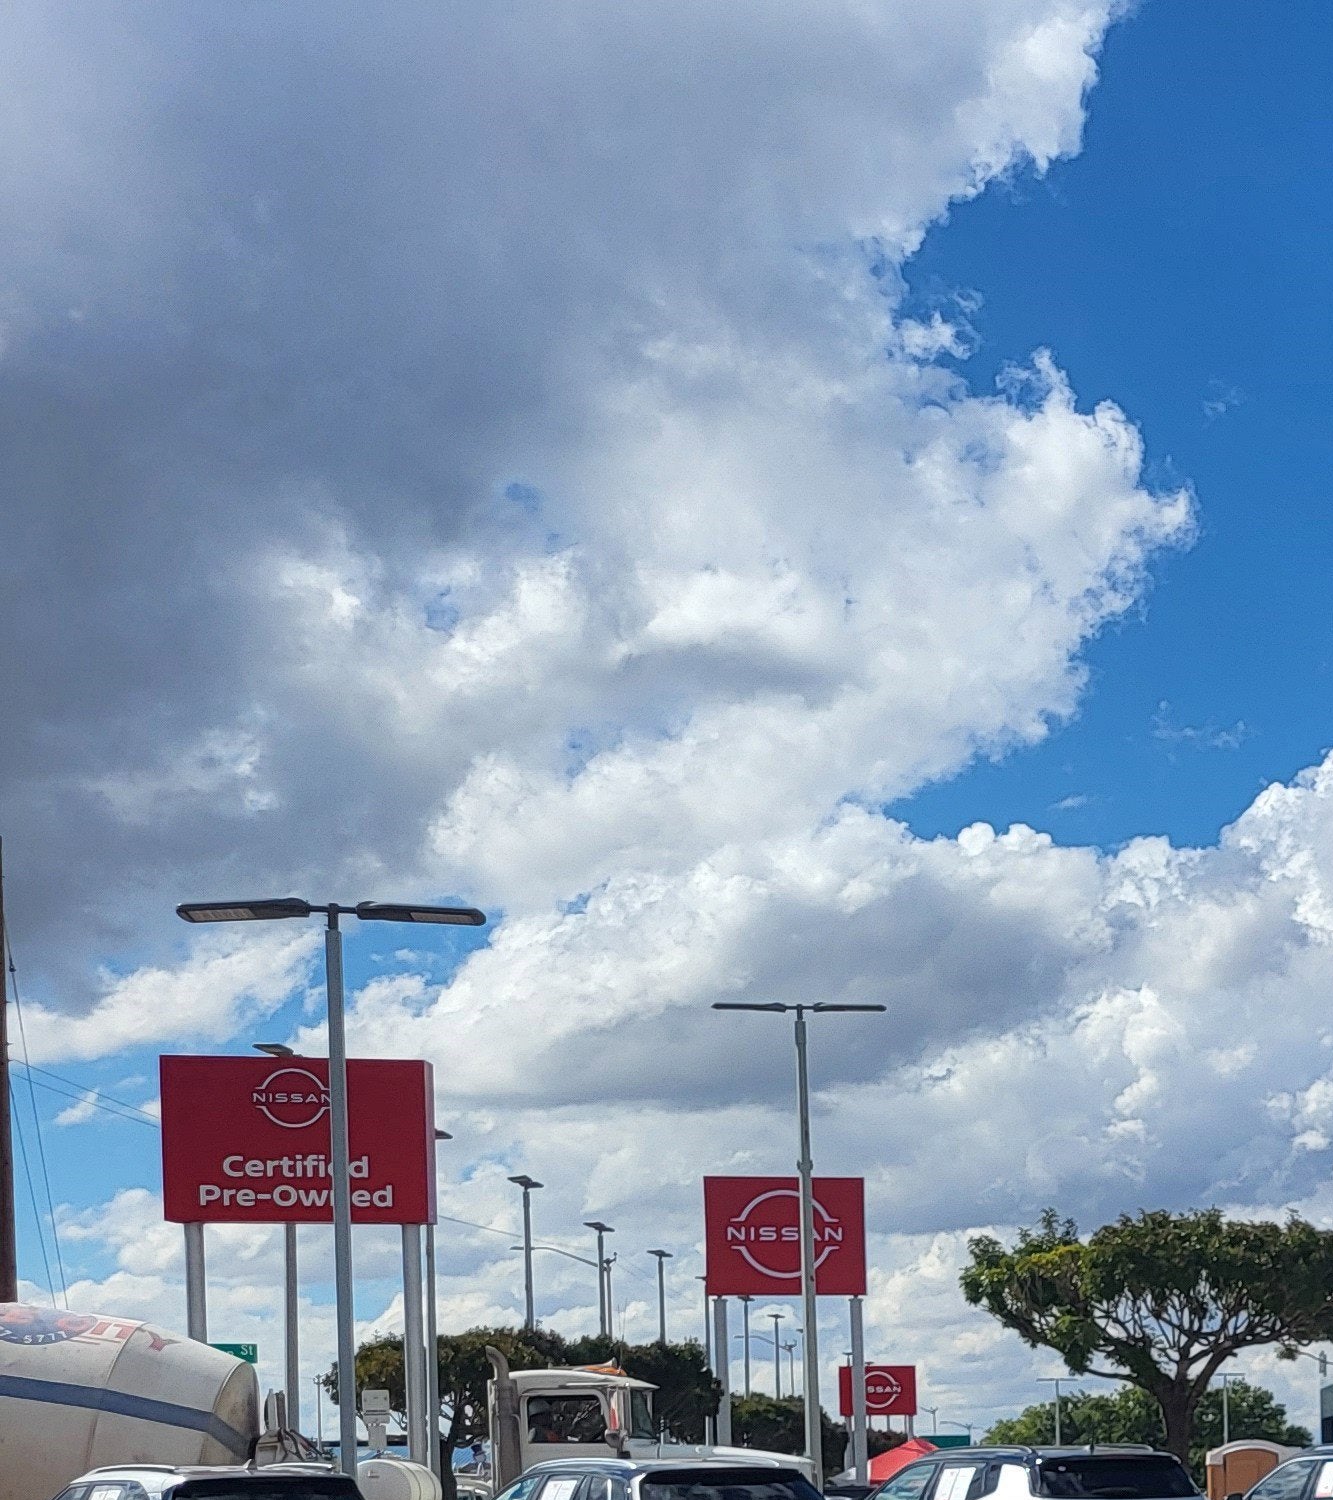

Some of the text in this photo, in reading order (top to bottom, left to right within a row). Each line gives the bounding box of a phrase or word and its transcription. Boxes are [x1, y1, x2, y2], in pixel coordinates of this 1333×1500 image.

[252, 1092, 331, 1104] NISSAN
[222, 1154, 369, 1179] Certifid
[198, 1184, 394, 1208] Pre-Owed
[240, 1344, 254, 1356] St
[867, 1385, 902, 1394] SSAN
